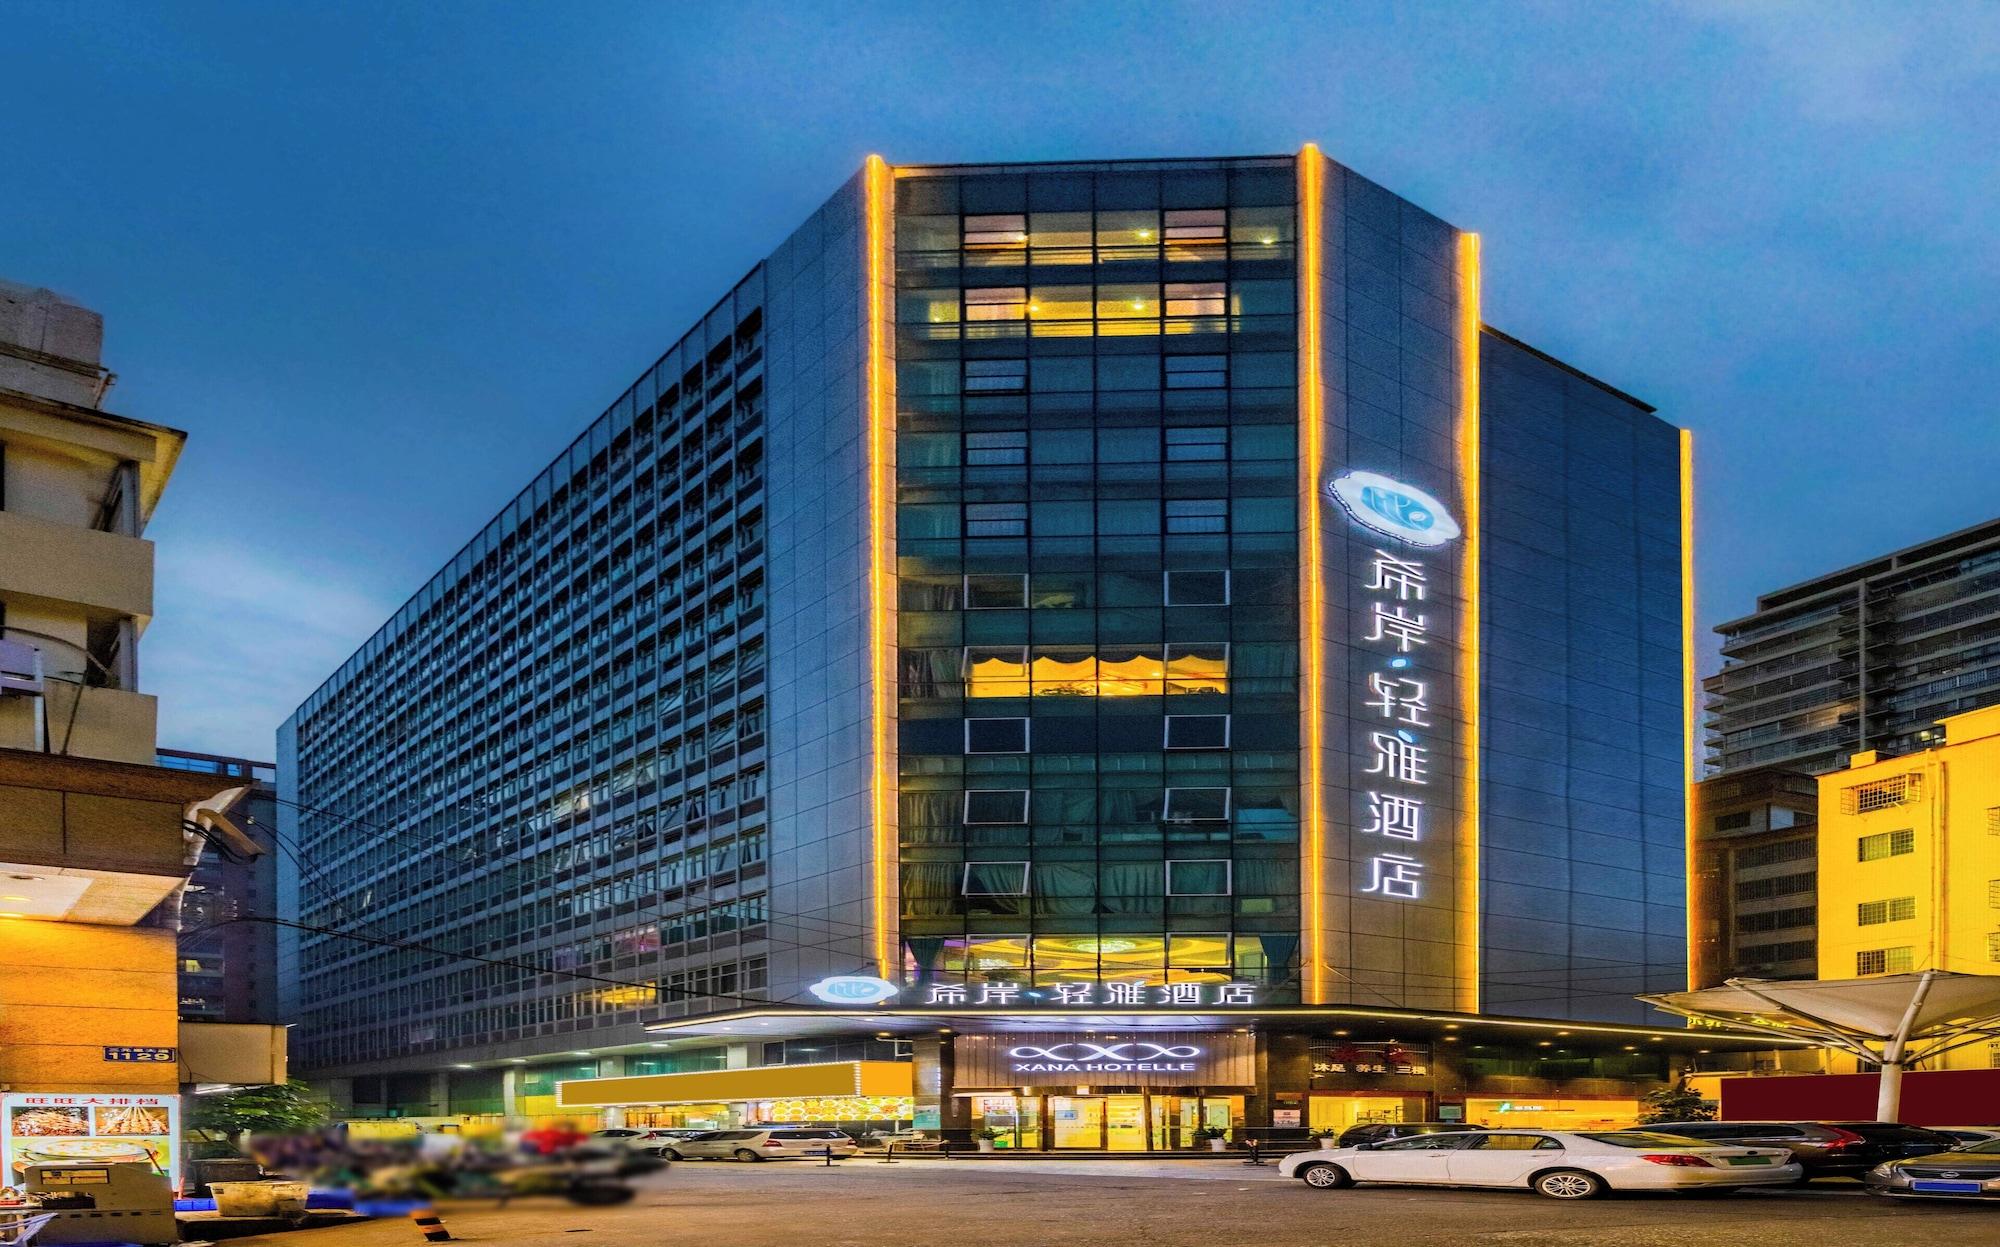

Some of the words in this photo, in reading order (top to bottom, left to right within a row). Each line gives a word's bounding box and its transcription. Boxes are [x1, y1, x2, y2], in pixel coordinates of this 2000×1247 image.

[108, 1052, 170, 1061] 1129
[1015, 1063, 1079, 1072] XANA
[1087, 1063, 1196, 1072] HOTELLE
[25, 1097, 159, 1105] 旺旺大排档
